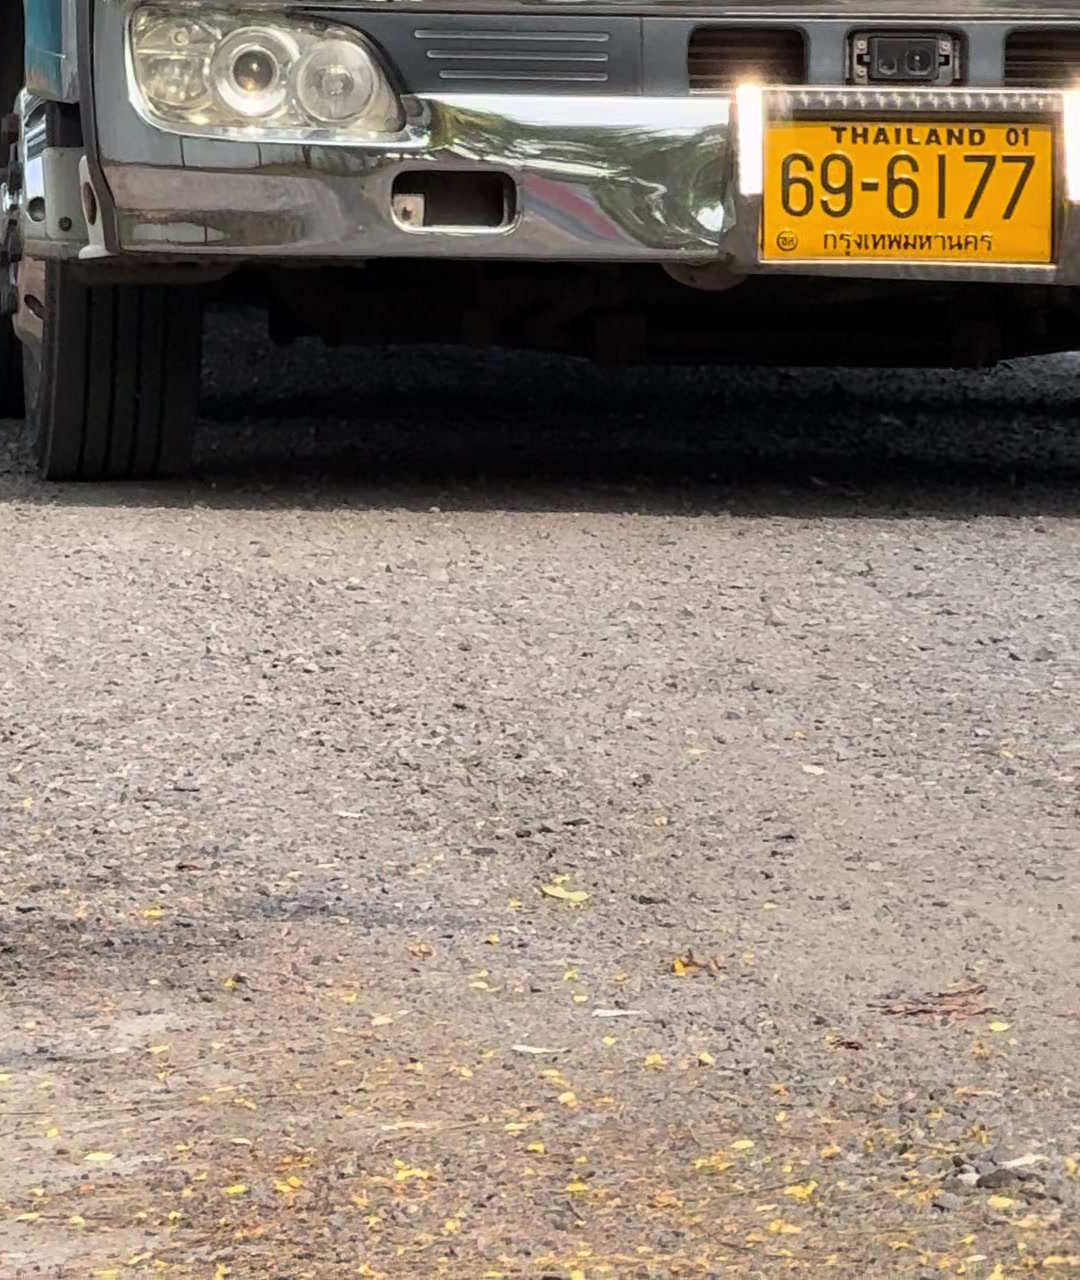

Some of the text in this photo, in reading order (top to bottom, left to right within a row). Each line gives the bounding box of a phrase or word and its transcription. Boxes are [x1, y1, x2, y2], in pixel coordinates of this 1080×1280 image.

[831, 126, 1029, 147] THAILAND 01
[780, 152, 1036, 220] 69-6177
[823, 232, 993, 256] กรุงเทพมหานคร
